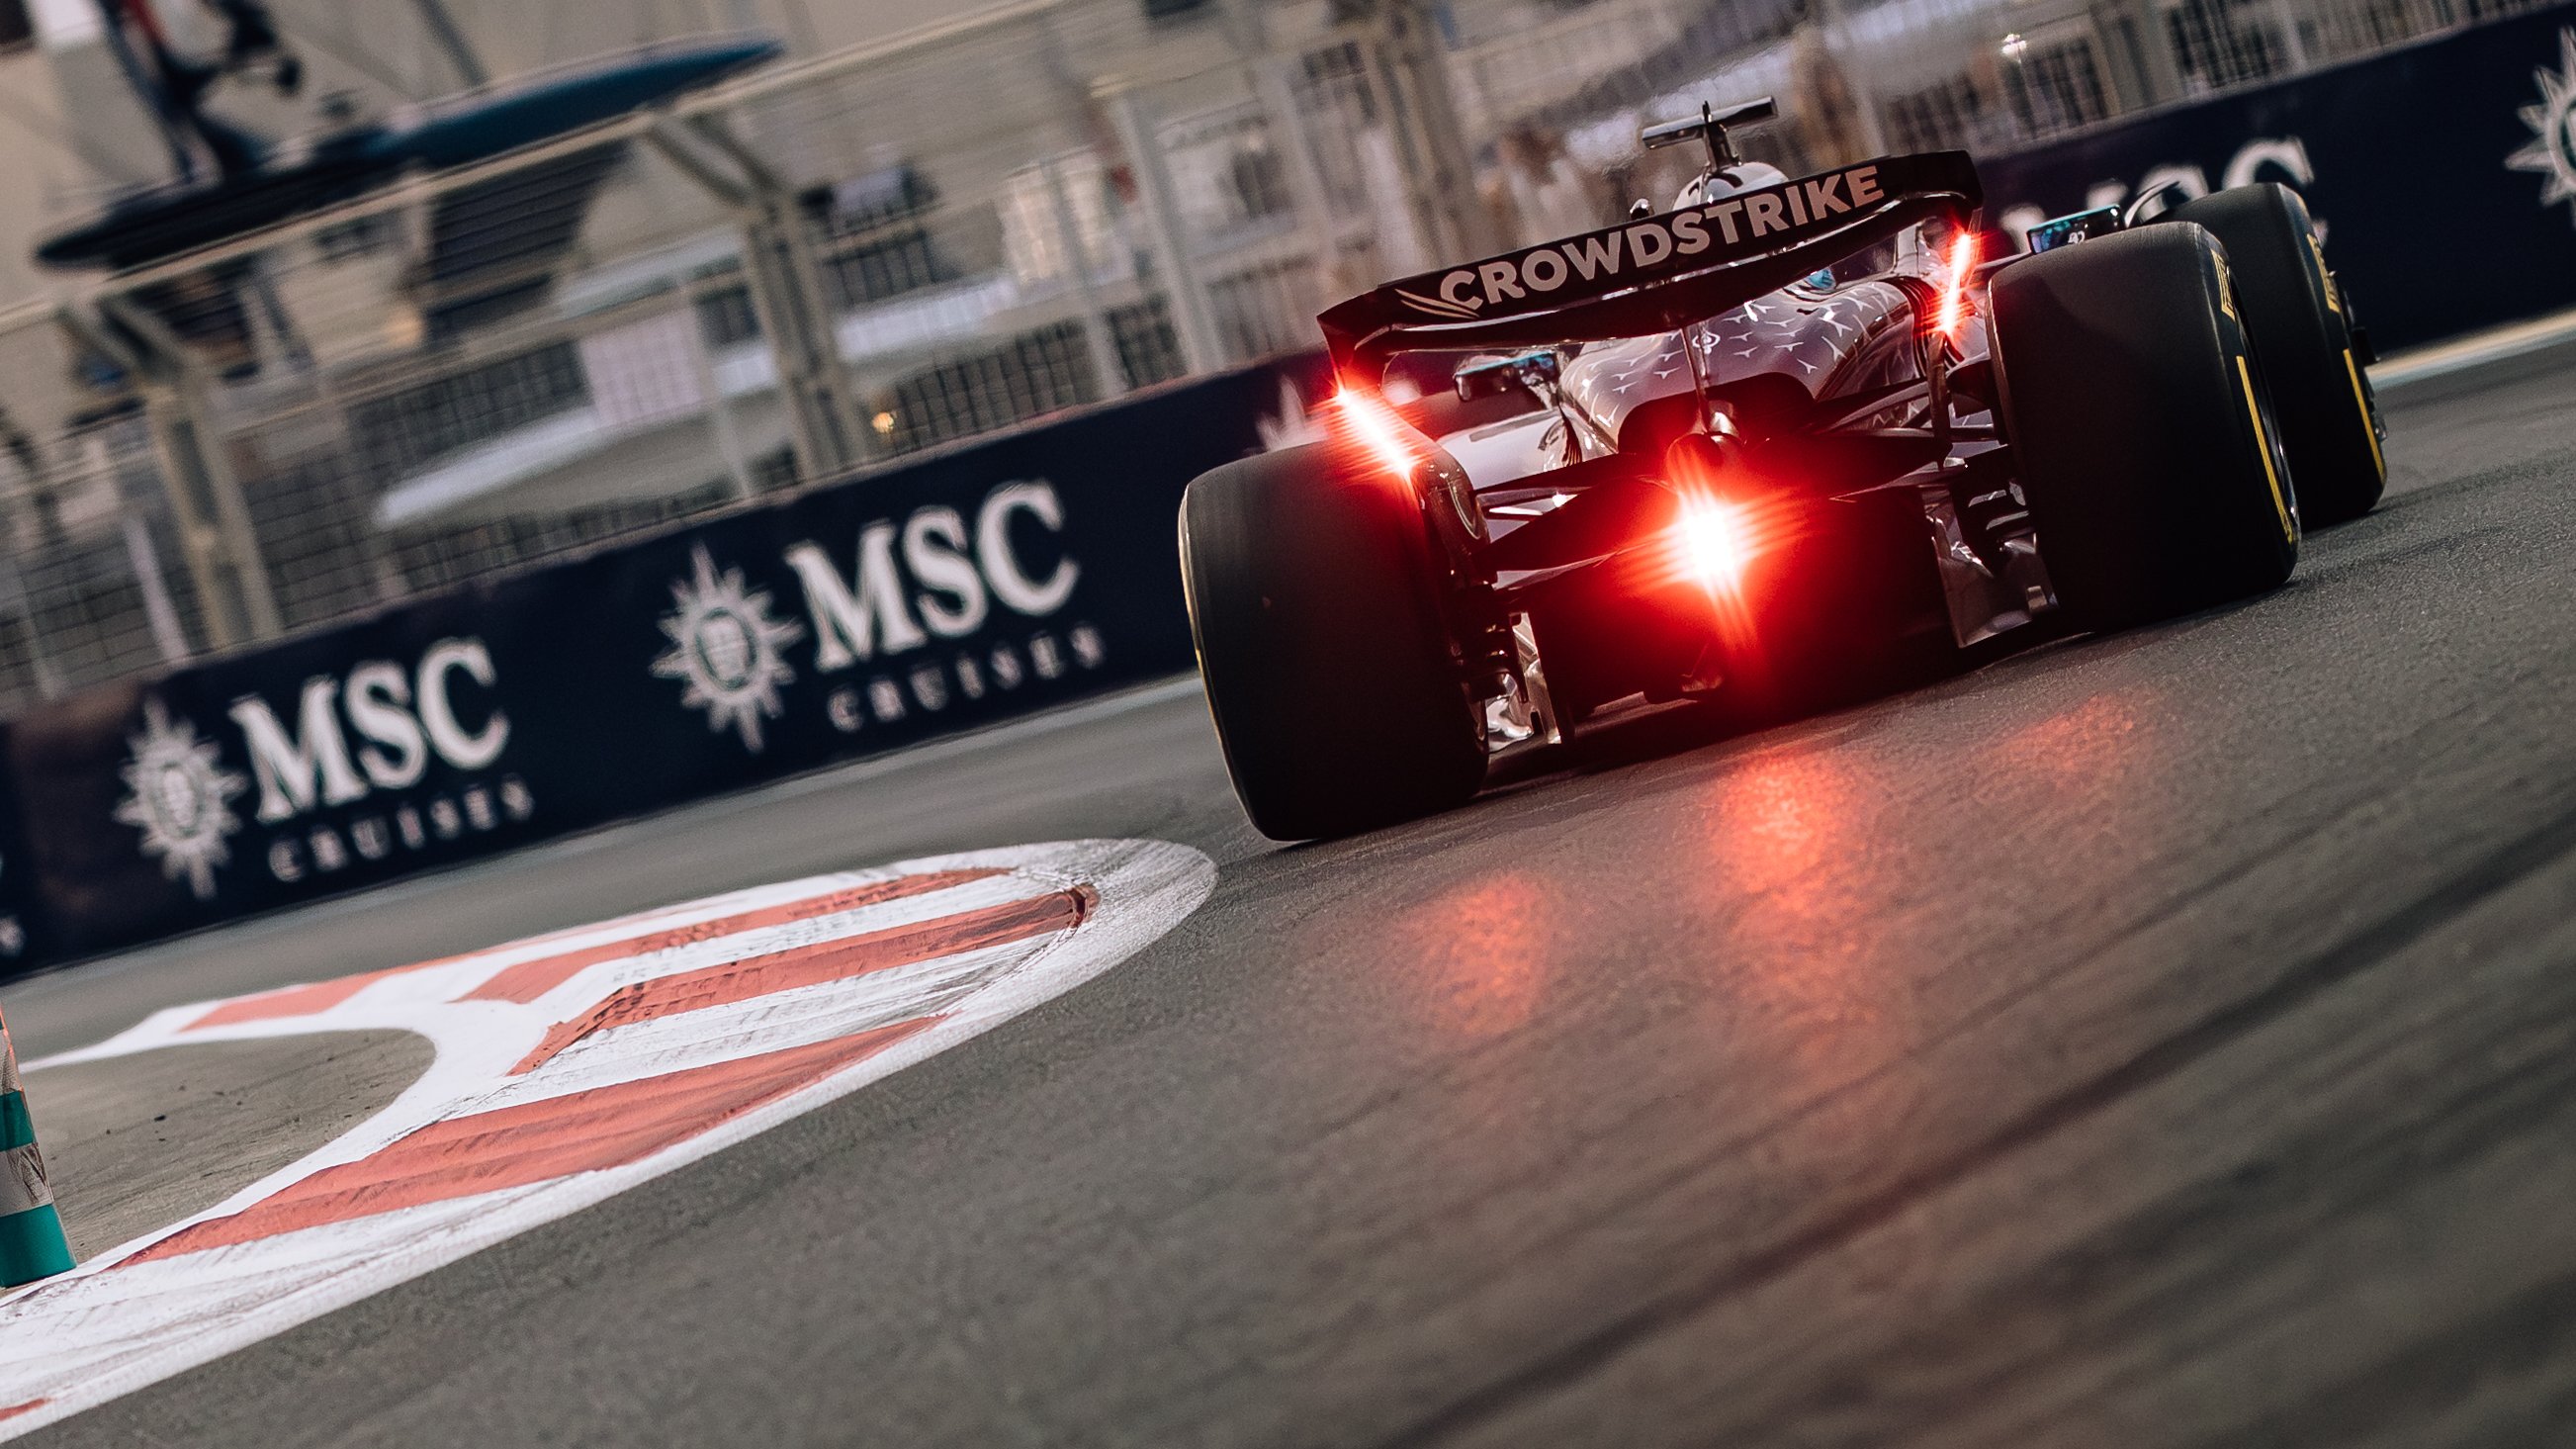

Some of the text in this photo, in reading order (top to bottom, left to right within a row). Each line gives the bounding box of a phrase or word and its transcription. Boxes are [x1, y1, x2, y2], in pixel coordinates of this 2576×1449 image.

[1439, 165, 1885, 312] CROWDSTRIKE
[785, 481, 1079, 669] MSC
[229, 637, 509, 822] MSC
